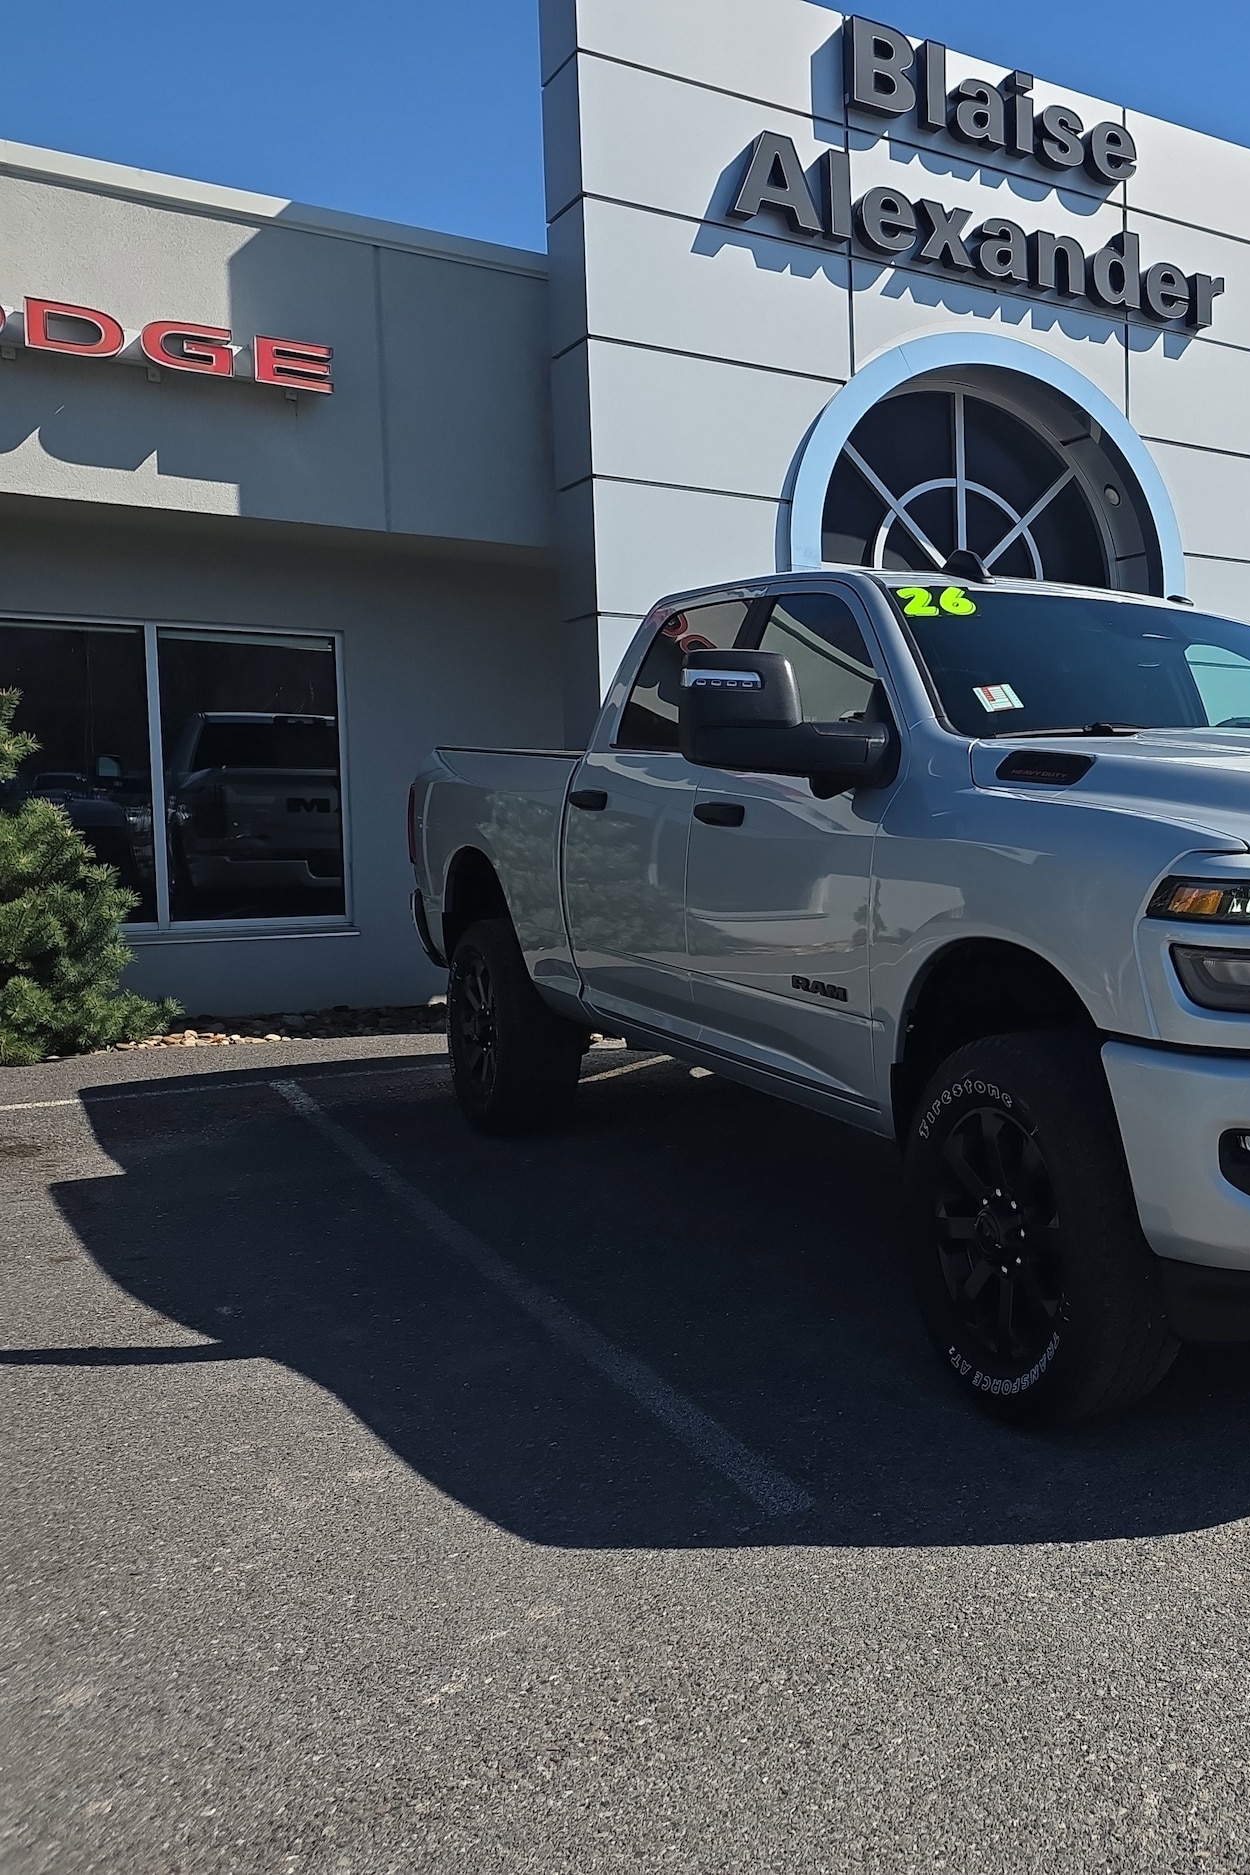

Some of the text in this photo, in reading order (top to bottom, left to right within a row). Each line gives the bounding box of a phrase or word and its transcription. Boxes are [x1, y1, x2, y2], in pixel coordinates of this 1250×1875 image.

[846, 14, 1139, 185] Blaise
[728, 130, 1226, 332] Alexander
[0, 296, 334, 396] DGE
[896, 586, 977, 616] 26
[1010, 767, 1069, 779] HEAVY DUTY
[791, 974, 848, 1003] RAM
[917, 1079, 1013, 1141] Firestone
[972, 1330, 1061, 1397] TRANSFORCE
